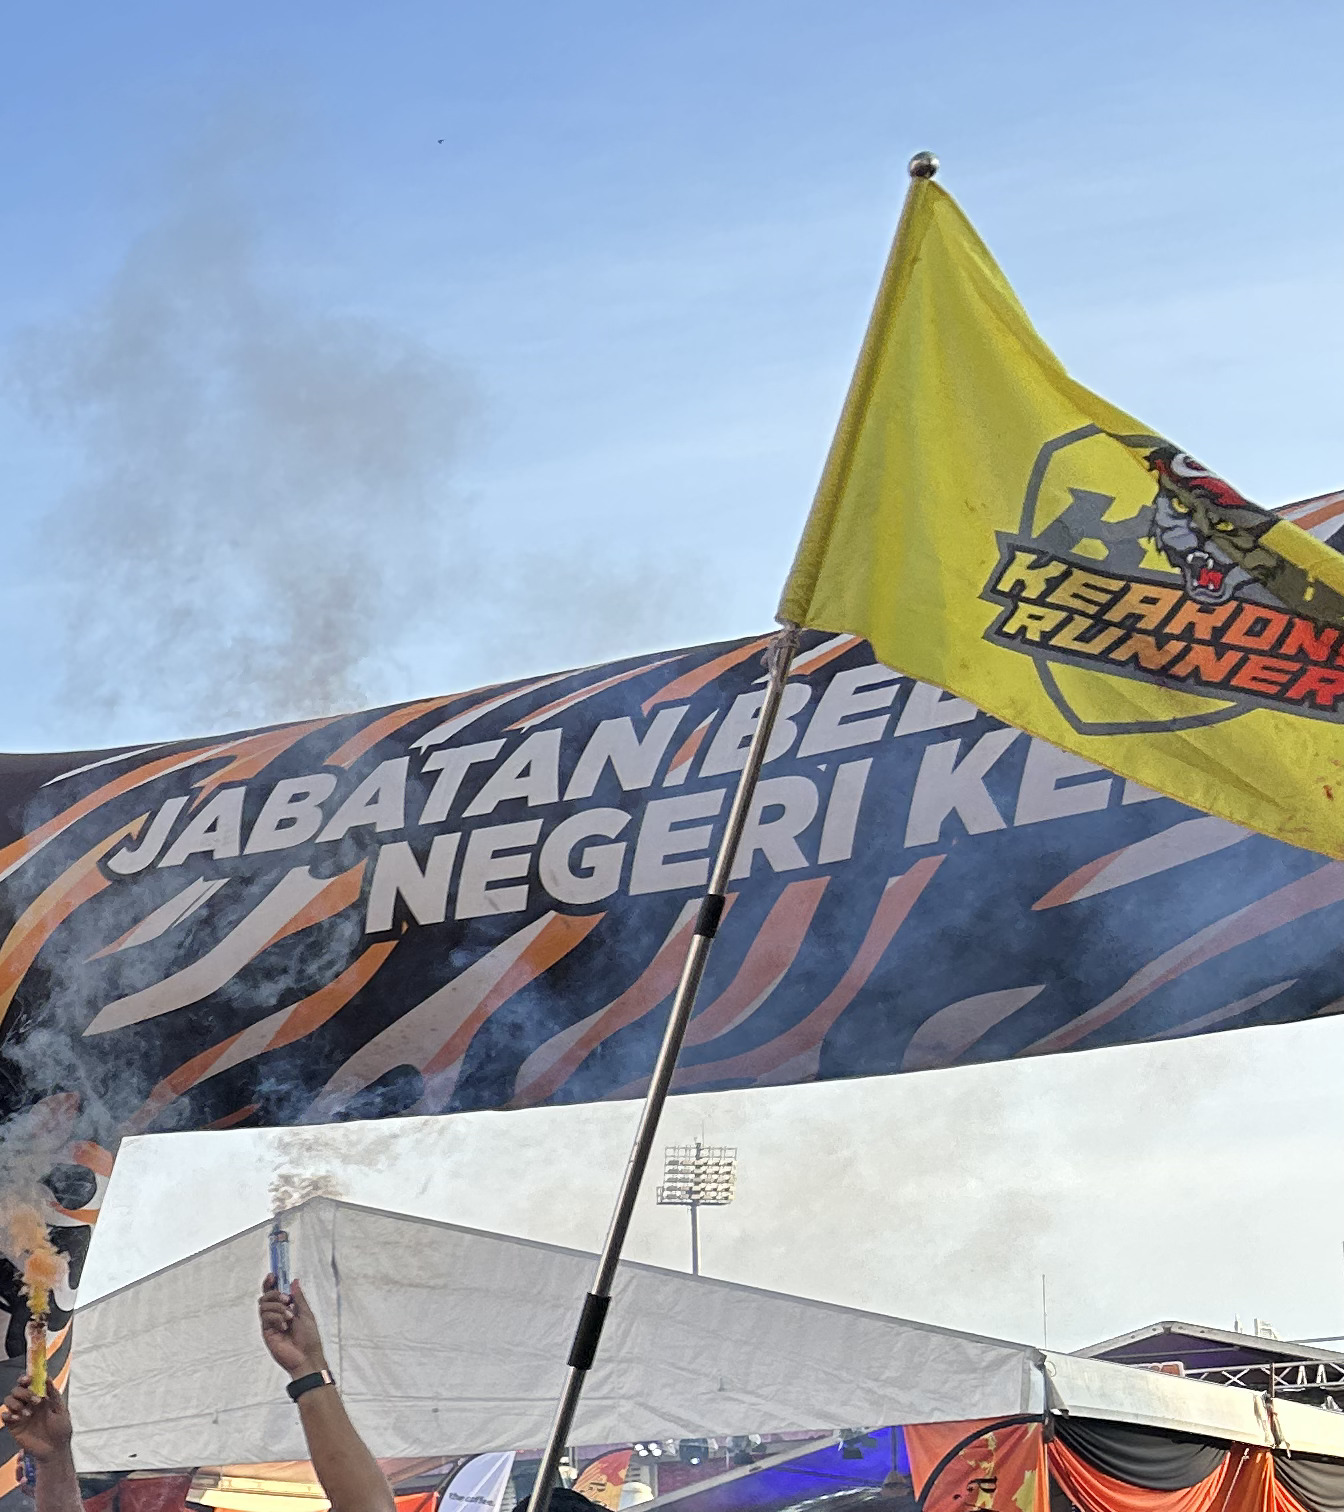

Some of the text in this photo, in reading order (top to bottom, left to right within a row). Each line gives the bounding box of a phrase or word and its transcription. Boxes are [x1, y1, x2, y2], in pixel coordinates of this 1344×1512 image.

[1002, 602, 1344, 707] RUNNER
[107, 662, 998, 875] JABATAN BEL
[365, 727, 1170, 935] NEGERI KE
